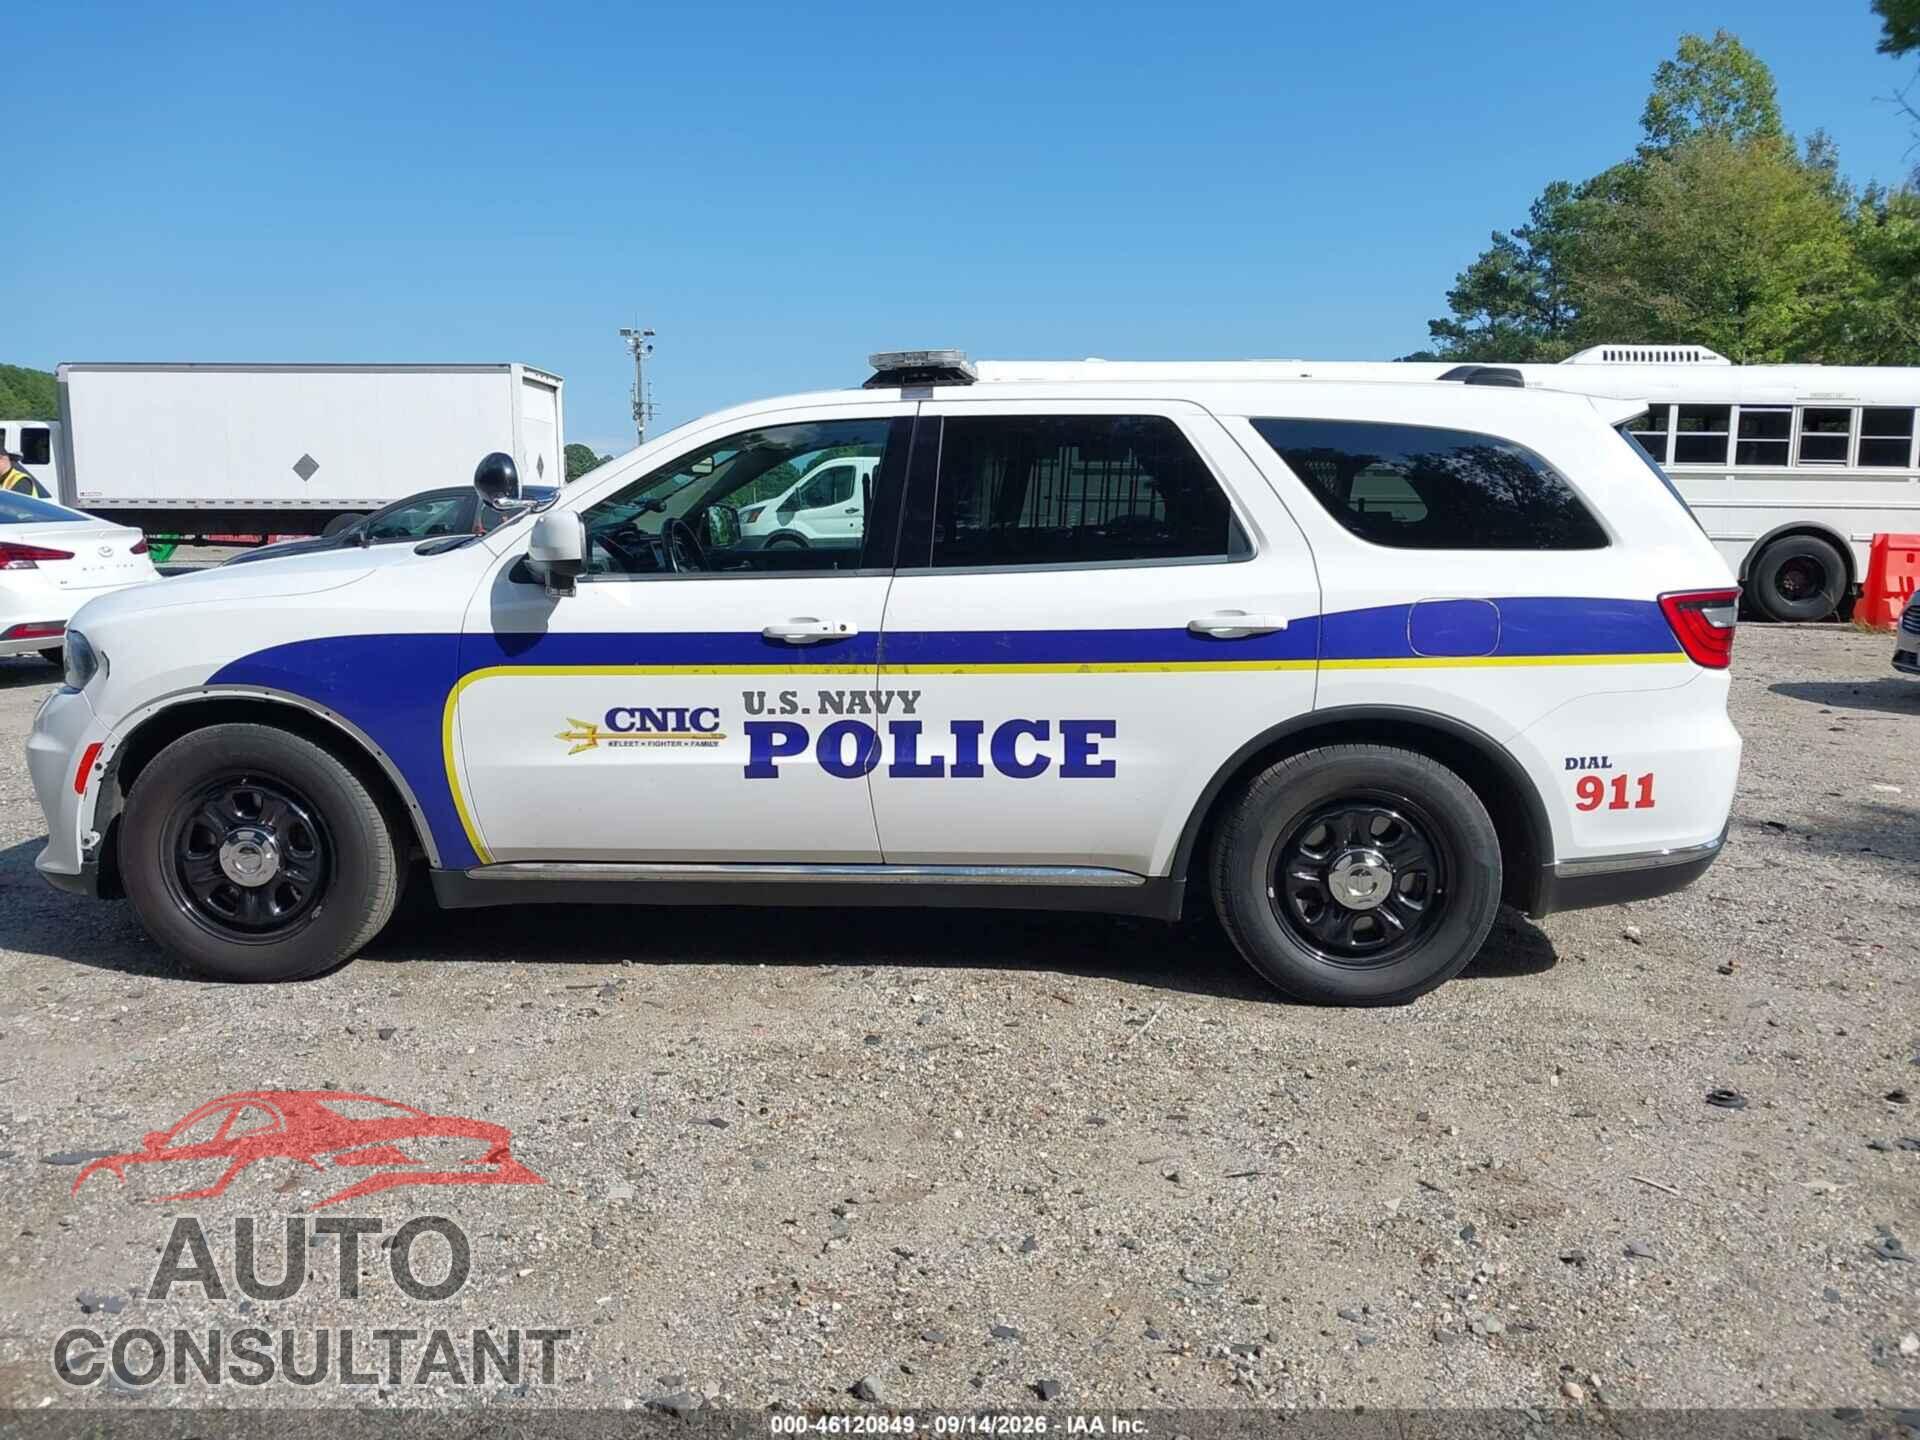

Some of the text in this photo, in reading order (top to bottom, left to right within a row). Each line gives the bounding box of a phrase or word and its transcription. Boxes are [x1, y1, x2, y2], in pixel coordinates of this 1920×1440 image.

[742, 690, 922, 715] U.S. NAVY
[604, 707, 720, 733] CNIC
[743, 719, 1117, 779] POLICE
[1565, 756, 1613, 770] DIAL
[1575, 773, 1656, 812] 911
